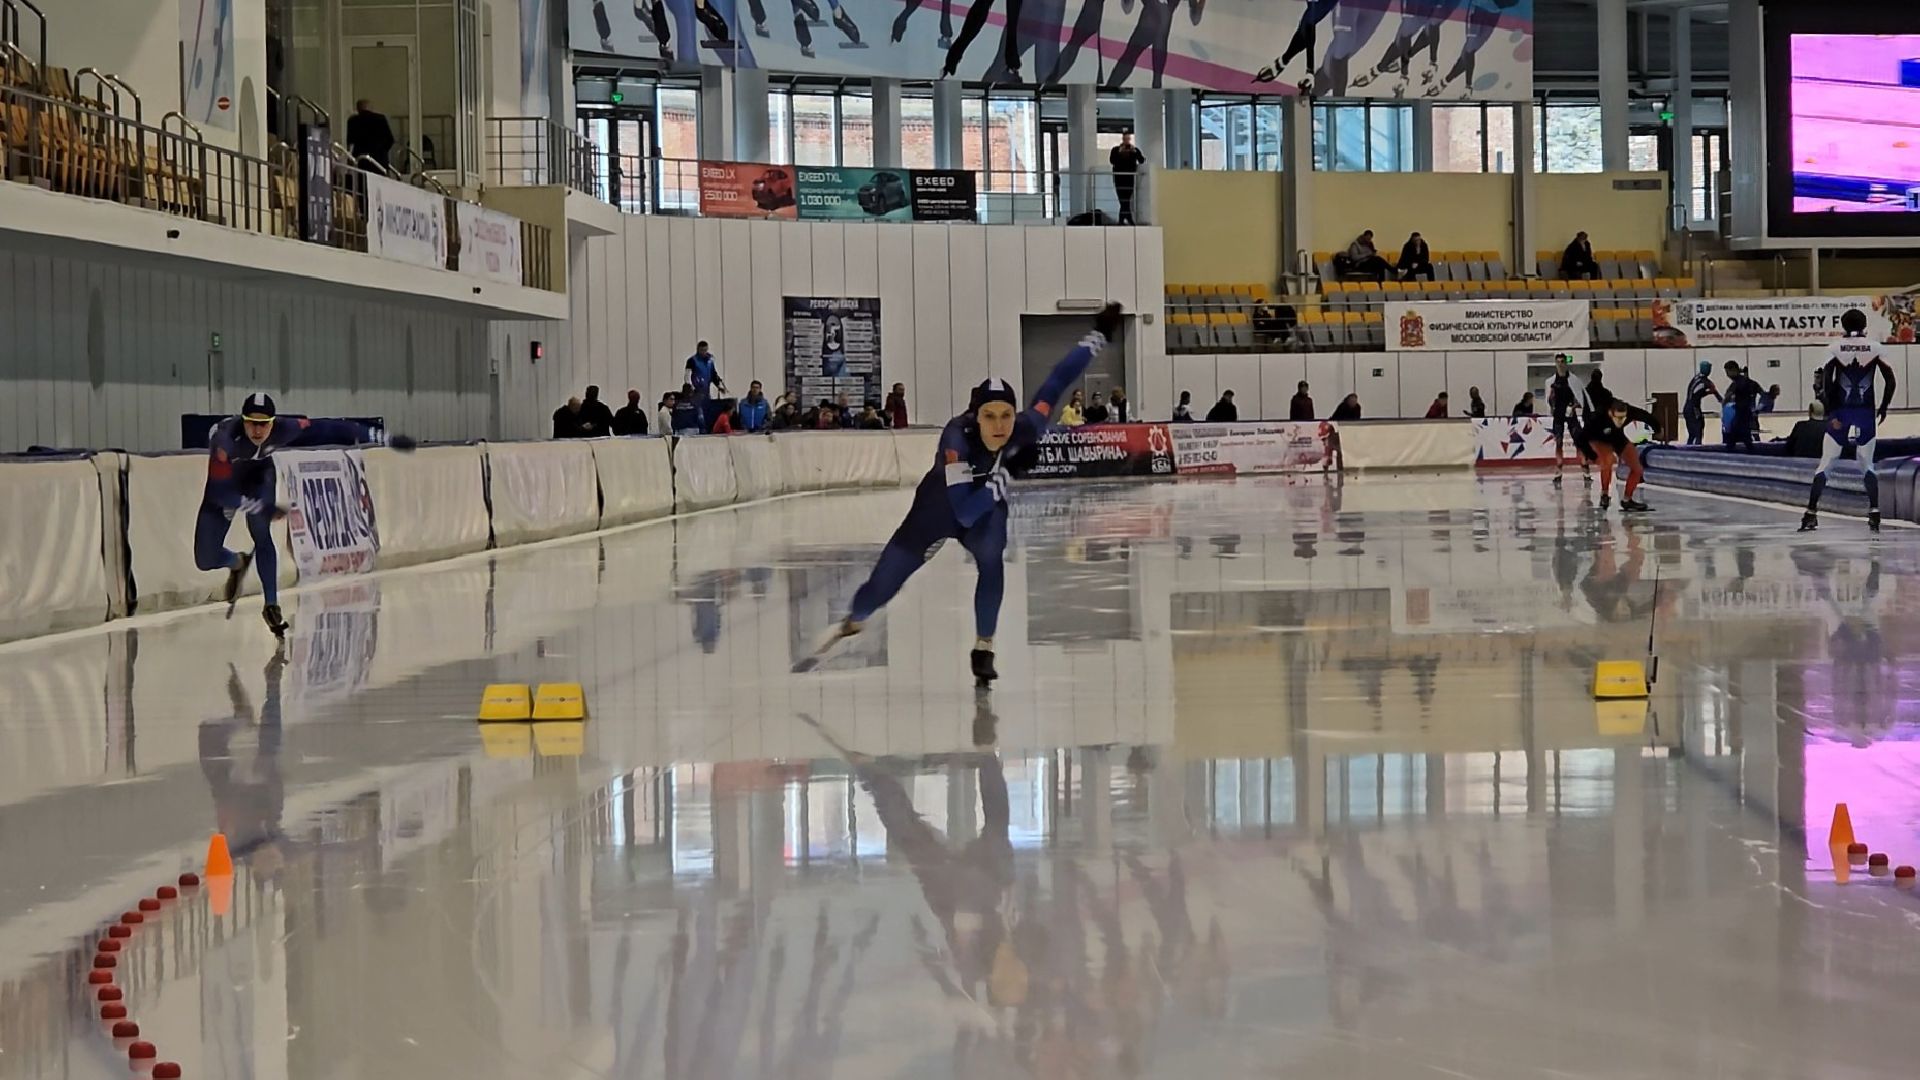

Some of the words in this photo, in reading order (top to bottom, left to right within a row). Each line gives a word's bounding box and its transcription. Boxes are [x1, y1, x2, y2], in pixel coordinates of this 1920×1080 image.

[702, 167, 725, 179] EXEED
[725, 168, 736, 180] LX
[798, 171, 825, 182] EXEED
[825, 172, 842, 183] TXL
[915, 176, 955, 186] EXEED
[1465, 309, 1533, 319] МИНИСТЕРСТВО
[1429, 321, 1485, 331] ФИЗИЧЕСКОЙ
[1486, 321, 1531, 330] КУЛЬТУРЫ
[1532, 321, 1538, 330] И
[1539, 320, 1574, 330] СПОРТА
[1695, 316, 1776, 331] KOLOMNA
[1779, 315, 1826, 329] TASTY
[1450, 332, 1510, 343] МОСКОВСКОЙ
[1511, 332, 1552, 343] ОБЛАСТИ
[1840, 344, 1871, 352] МОСКВА
[1071, 431, 1127, 444] СОРЕВНОВАНИЯ
